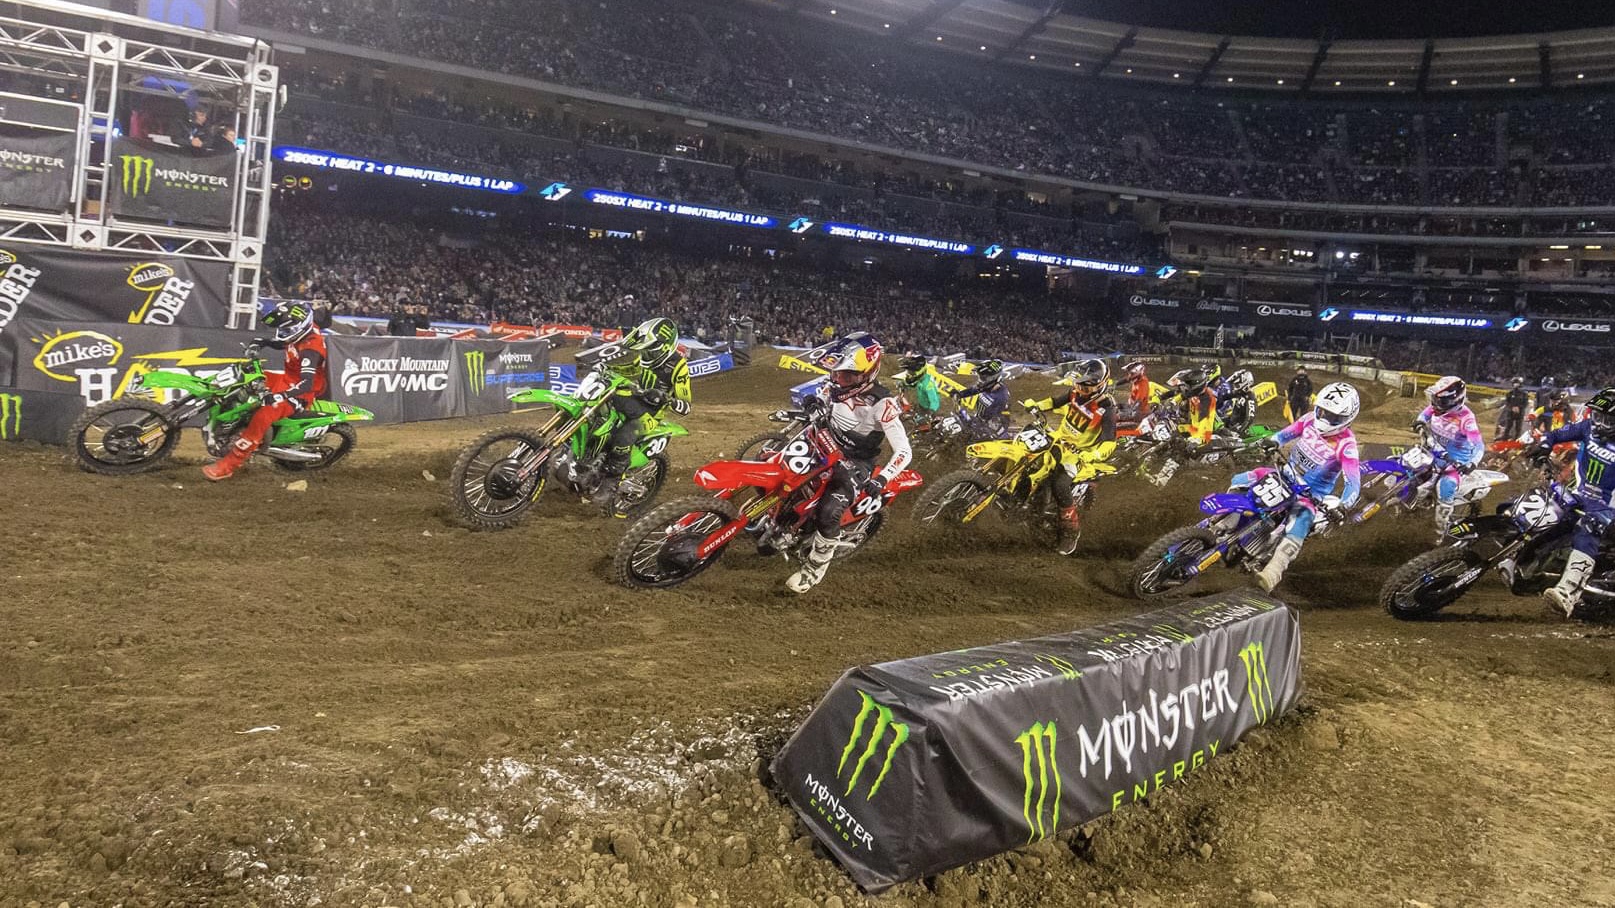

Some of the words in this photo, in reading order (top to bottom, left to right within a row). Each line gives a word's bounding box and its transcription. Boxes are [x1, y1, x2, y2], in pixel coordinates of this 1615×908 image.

[0, 150, 65, 169] ONSTER
[283, 151, 327, 166] 250SX
[329, 157, 365, 171] HEAT
[365, 162, 375, 173] 2
[383, 164, 393, 175] 6
[394, 165, 482, 187] MINUTES/PLUS
[483, 178, 490, 187] 1
[490, 179, 513, 190] LAP
[154, 168, 228, 188] MONSTER
[593, 193, 626, 206] 250SX
[627, 198, 654, 209] HEAT
[654, 202, 662, 211] 2
[668, 204, 676, 213] 6
[677, 205, 744, 223] MINUTES/PLUS
[745, 214, 750, 223] 1
[750, 215, 769, 225] LAP
[856, 230, 878, 240] HEAT
[877, 233, 884, 241] 2
[953, 243, 968, 252] LAP
[1125, 265, 1140, 273] LAP
[144, 276, 195, 326] DER
[1143, 298, 1179, 307] LEXUS
[1272, 308, 1313, 317] LEXUS
[1471, 319, 1488, 327] LAP
[1560, 323, 1611, 332] LEXUS
[45, 343, 116, 368] mike's
[361, 356, 398, 372] ROCKY
[400, 356, 450, 372] MOUNTAIN
[499, 352, 533, 364] MONSTER
[689, 359, 720, 376] WPS
[1067, 407, 1089, 430] FLY
[302, 425, 330, 439] 101
[646, 437, 668, 457] 30
[782, 440, 816, 475] 96
[1587, 440, 1615, 463] THOR
[1252, 477, 1286, 508] 35
[855, 496, 882, 515] 96
[1515, 494, 1558, 528] 26
[703, 526, 737, 553] DUNLOP
[931, 658, 1009, 680] ENERGY
[929, 664, 1053, 702] MONSTER
[1077, 668, 1239, 780] MONSTER
[805, 773, 873, 851] MONSTER
[810, 798, 858, 848] ENERGY
